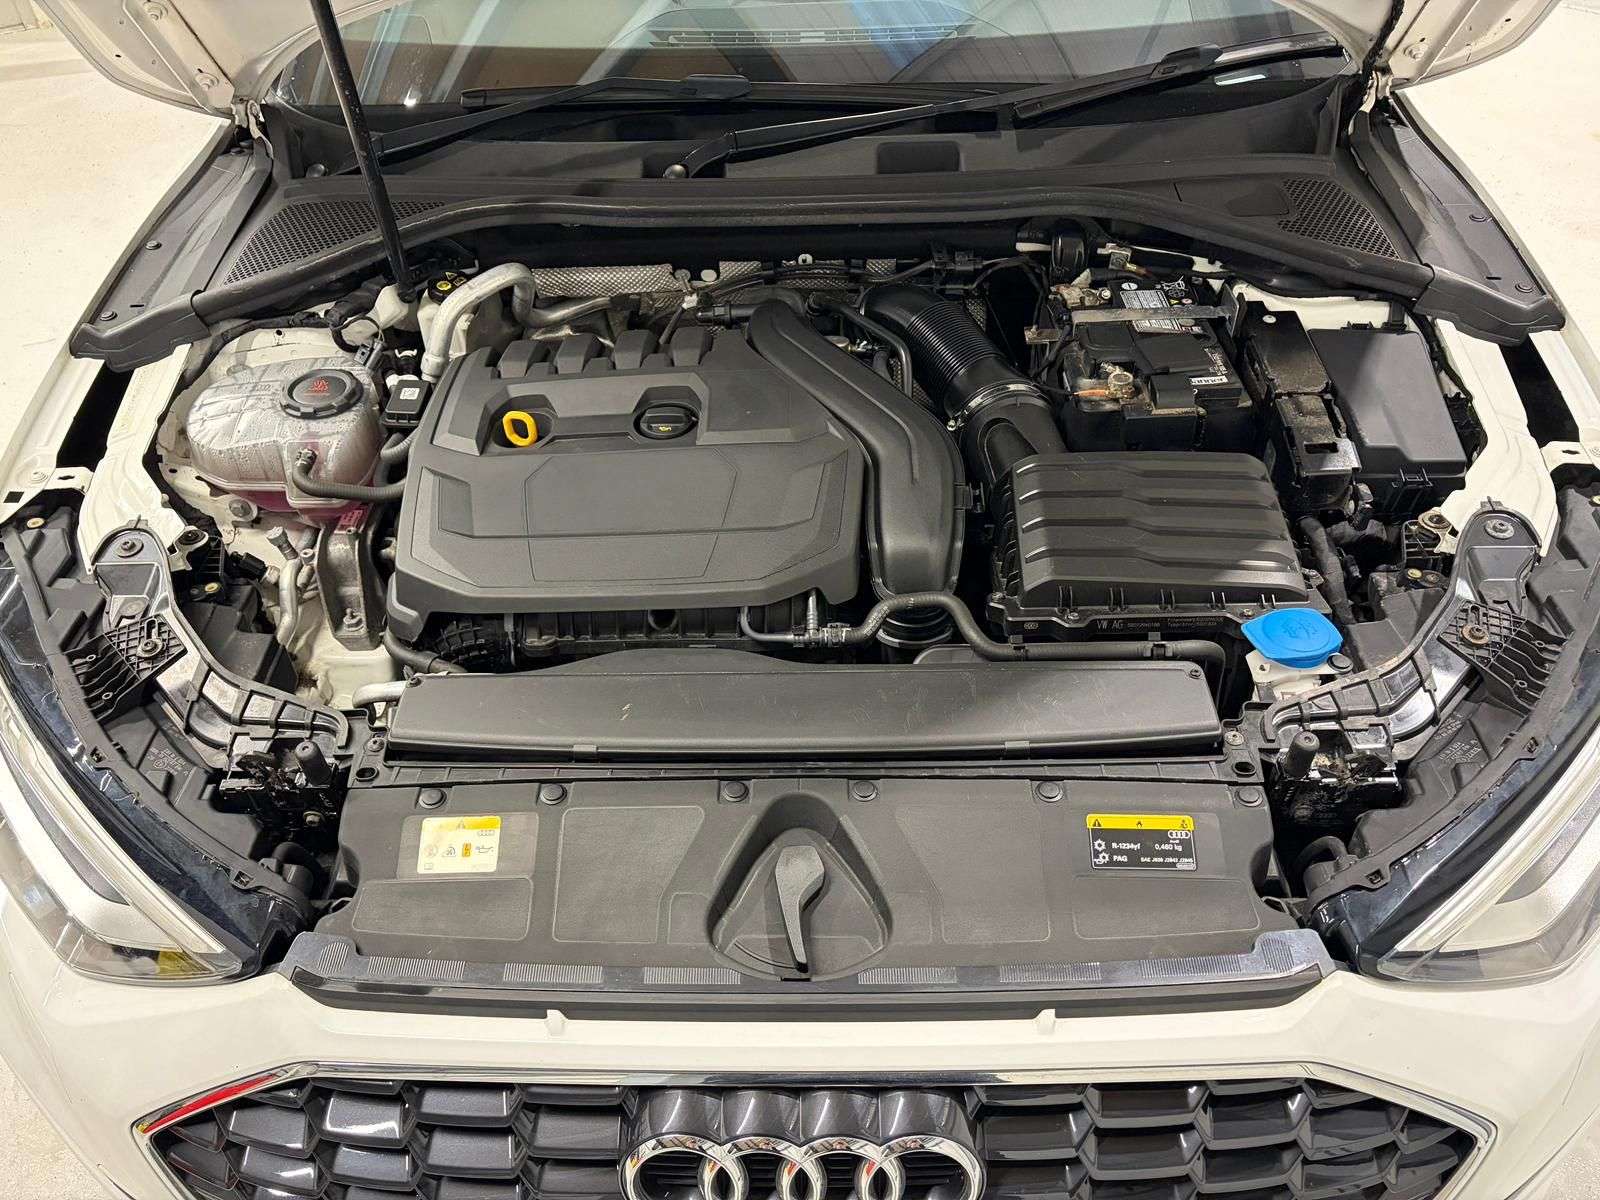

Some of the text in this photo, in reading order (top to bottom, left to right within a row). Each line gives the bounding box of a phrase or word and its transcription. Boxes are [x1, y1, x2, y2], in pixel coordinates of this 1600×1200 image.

[1096, 619, 1108, 630] VW
[1111, 619, 1124, 631] AG
[1112, 842, 1141, 851] R-1234yf
[1174, 843, 1183, 852] kg
